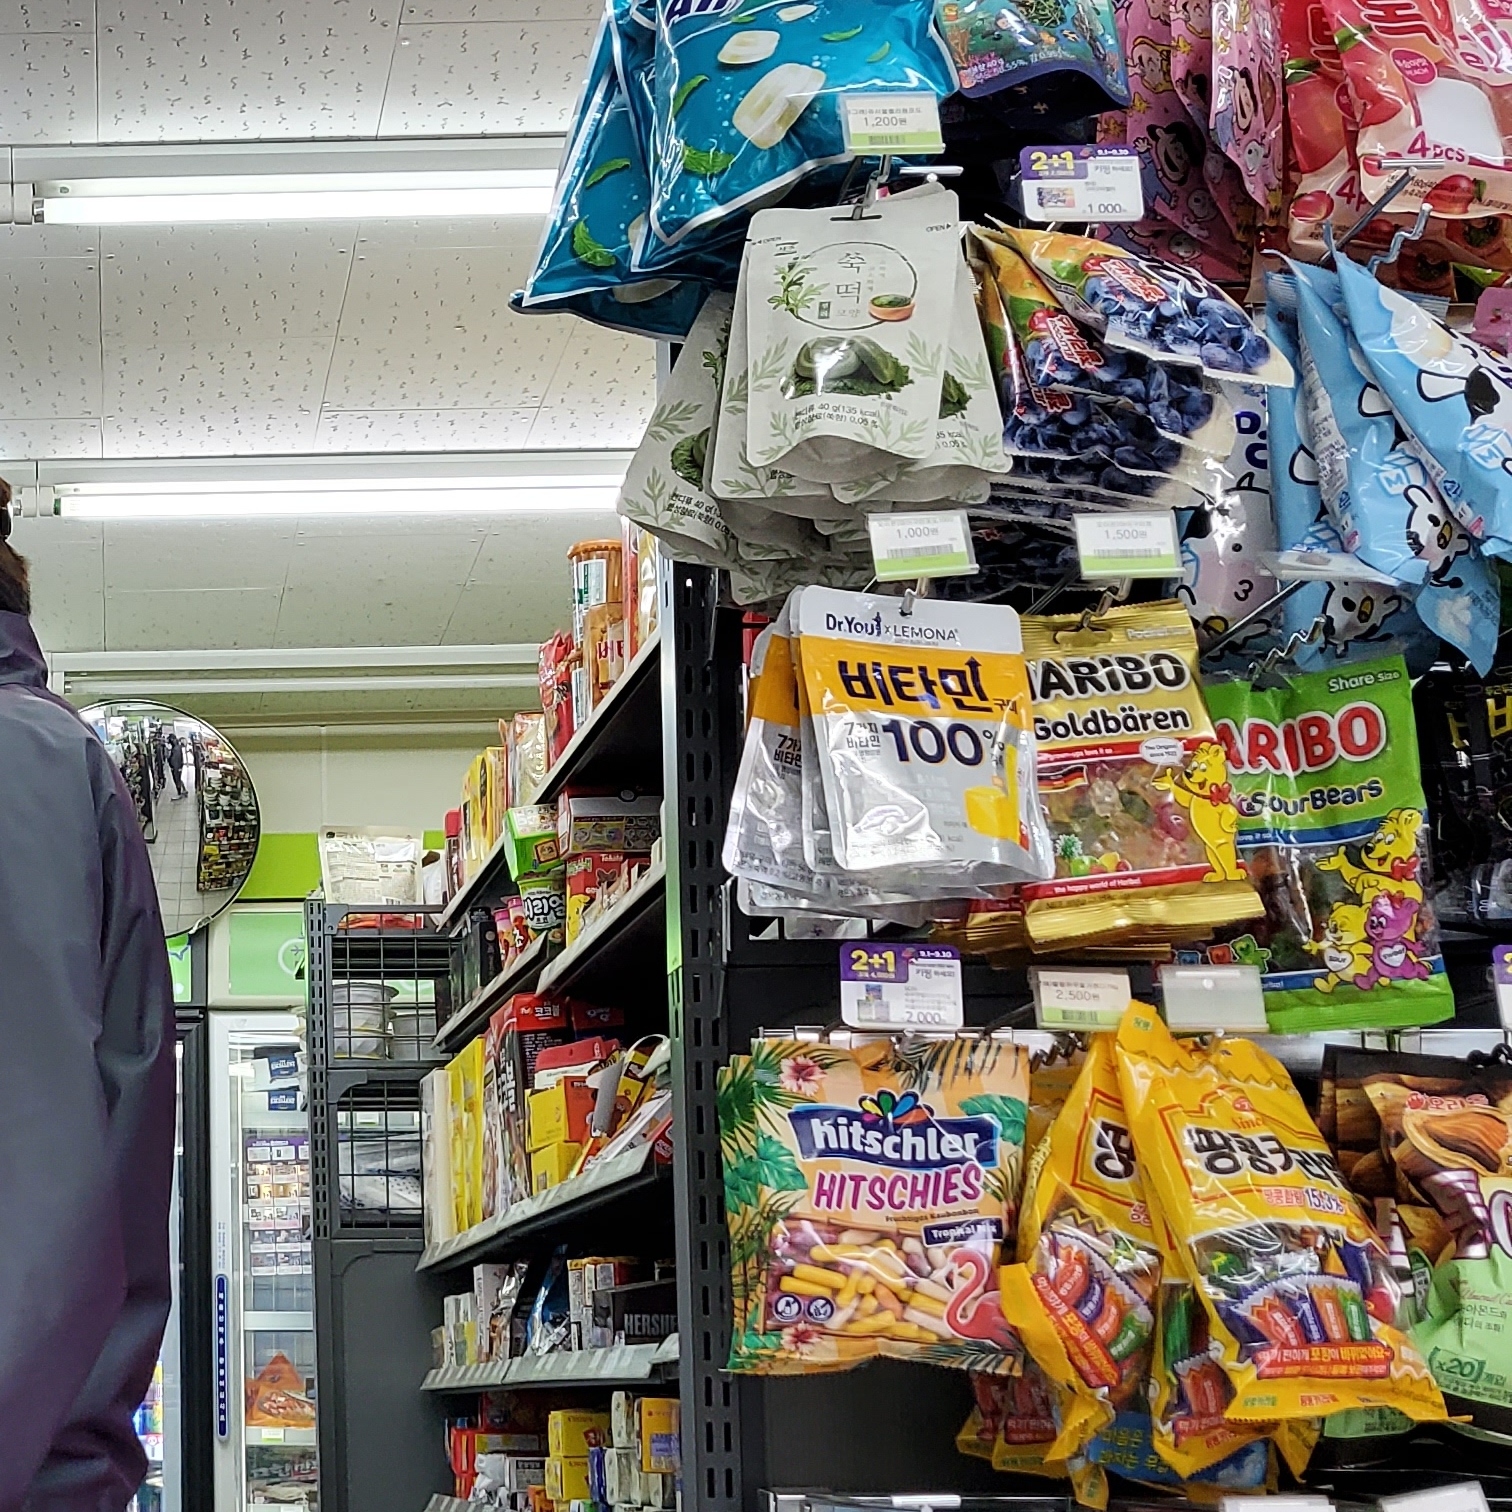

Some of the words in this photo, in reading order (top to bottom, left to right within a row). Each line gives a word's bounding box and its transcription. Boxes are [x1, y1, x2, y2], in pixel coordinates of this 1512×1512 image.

[864, 116, 908, 128] 1,200원
[1030, 150, 1075, 171] 2+1
[896, 527, 940, 540] 1,000원
[1104, 528, 1148, 541] 1,500원
[826, 613, 875, 635] Dr.You
[893, 624, 957, 642] LEMONA
[838, 658, 994, 714] 비타민
[1025, 652, 1190, 702] ARIBO
[1328, 672, 1375, 693] Share
[1377, 670, 1400, 683] Size
[1033, 705, 1191, 742] Goldbären
[846, 735, 881, 749] 비타민
[1216, 704, 1383, 772] ARIBO
[851, 949, 896, 974] 2+1
[813, 1116, 981, 1163] hitschler
[813, 1162, 981, 1211] HITSCHIES
[931, 1225, 975, 1241] Tropical
[624, 1314, 678, 1336] HERSHE
